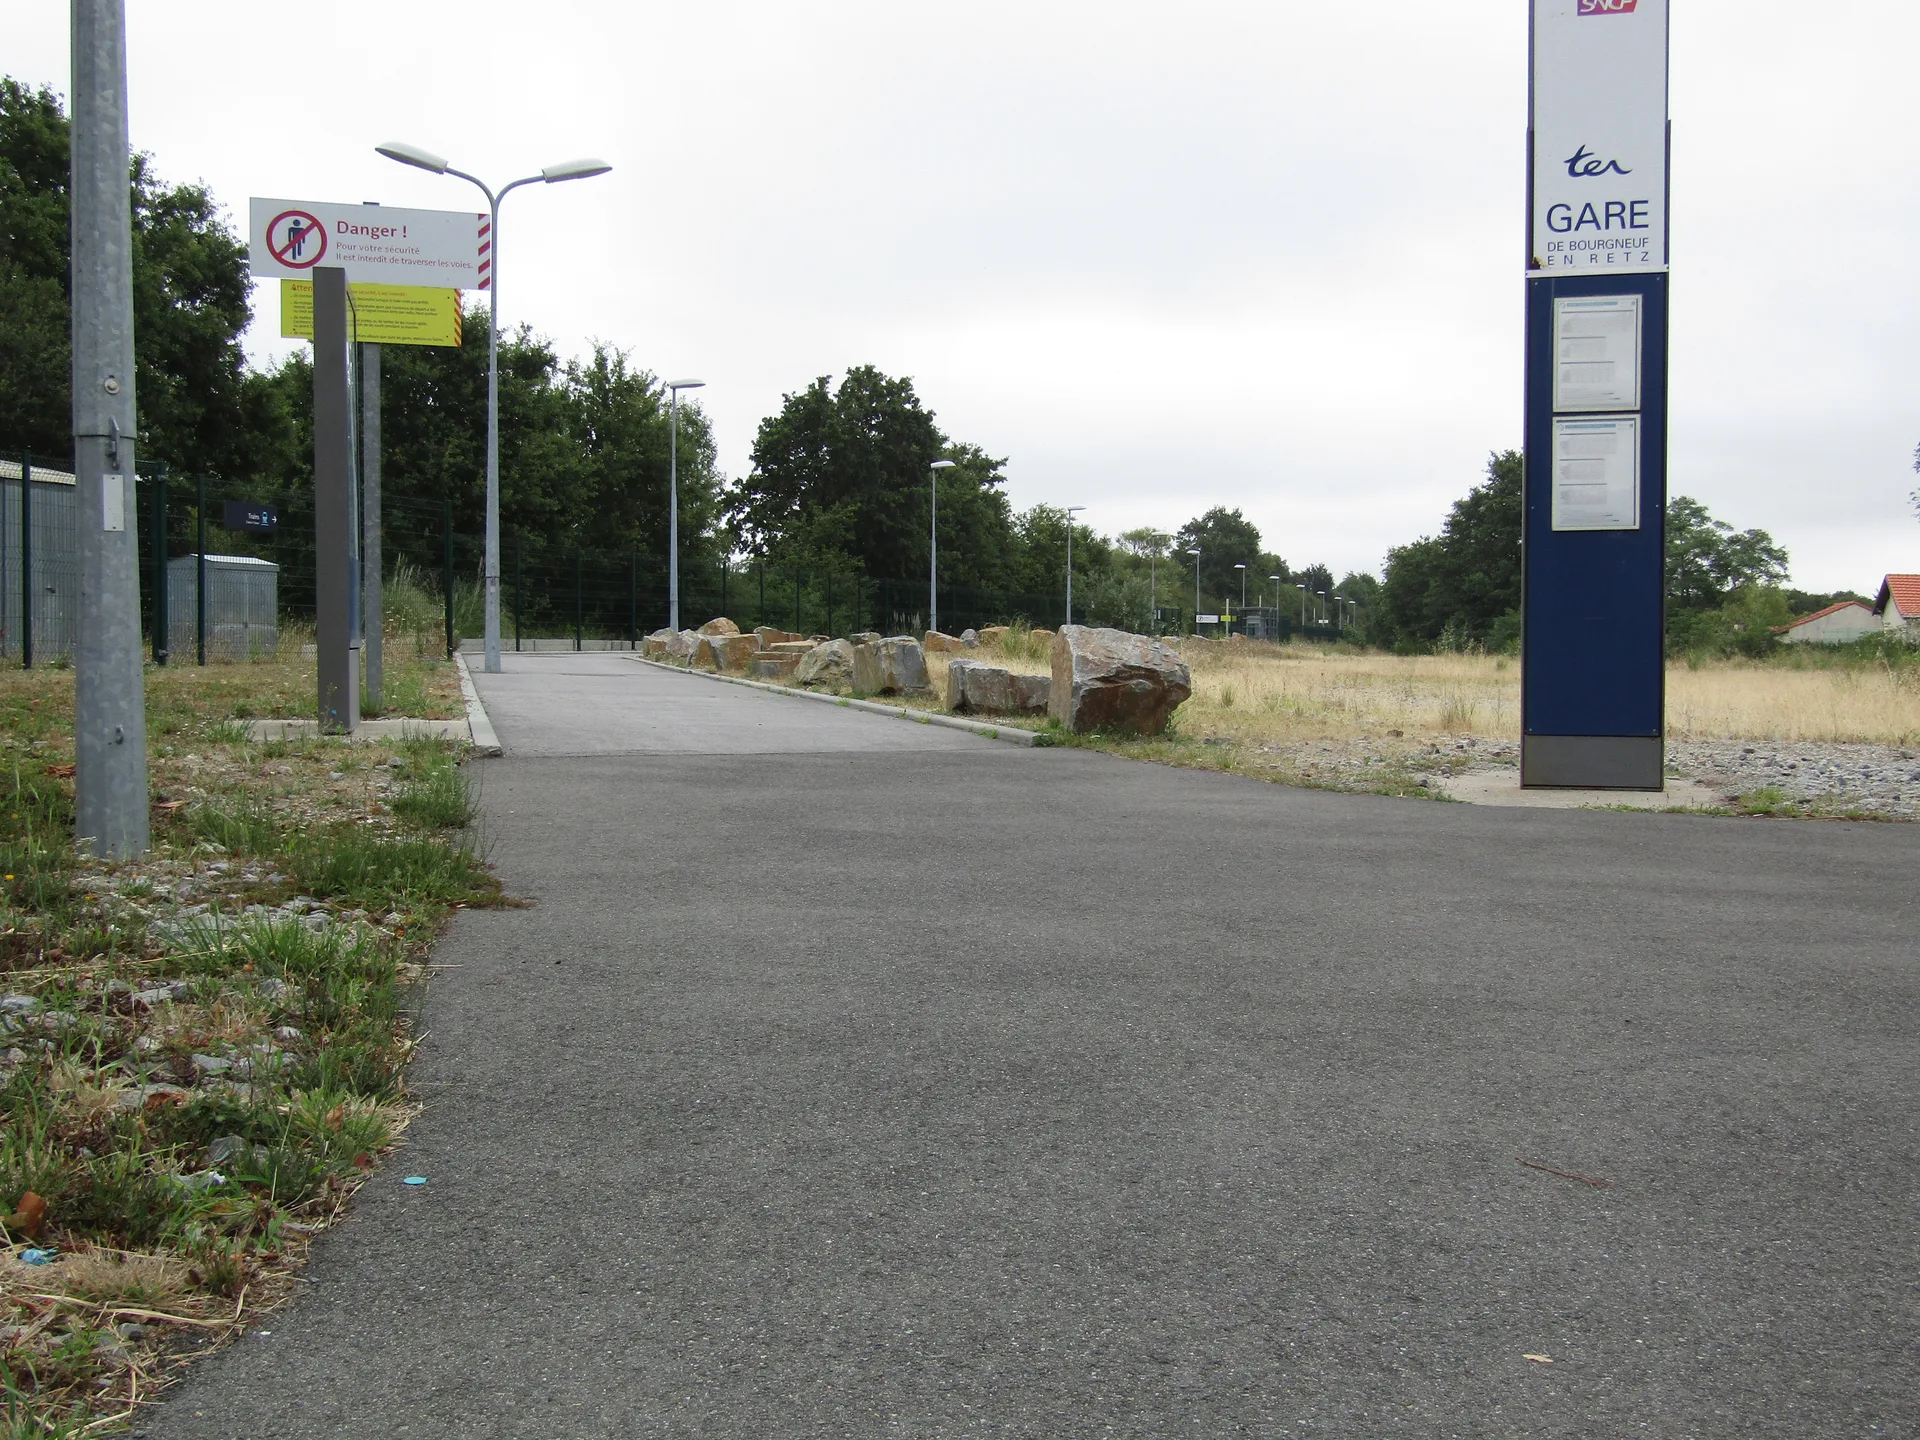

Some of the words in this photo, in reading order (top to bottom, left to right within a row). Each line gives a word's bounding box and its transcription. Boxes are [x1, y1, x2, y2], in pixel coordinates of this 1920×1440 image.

[1563, 144, 1633, 178] ter
[1546, 200, 1649, 233] GARE
[337, 220, 397, 240] Danger
[403, 225, 407, 238] !
[336, 241, 356, 251] Pour
[359, 244, 382, 253] votre
[385, 245, 420, 255] sécurité
[1547, 241, 1564, 252] DE
[1569, 237, 1649, 251] BOURGNEUF
[336, 252, 341, 260] Il
[343, 253, 356, 262] est
[357, 253, 387, 264] interdit
[389, 256, 400, 264] de
[401, 257, 437, 267] traverser
[438, 259, 450, 268] les
[450, 260, 474, 269] voies.
[1547, 254, 1573, 266] EN
[1590, 251, 1649, 264] RETZ
[291, 283, 313, 292] Atten
